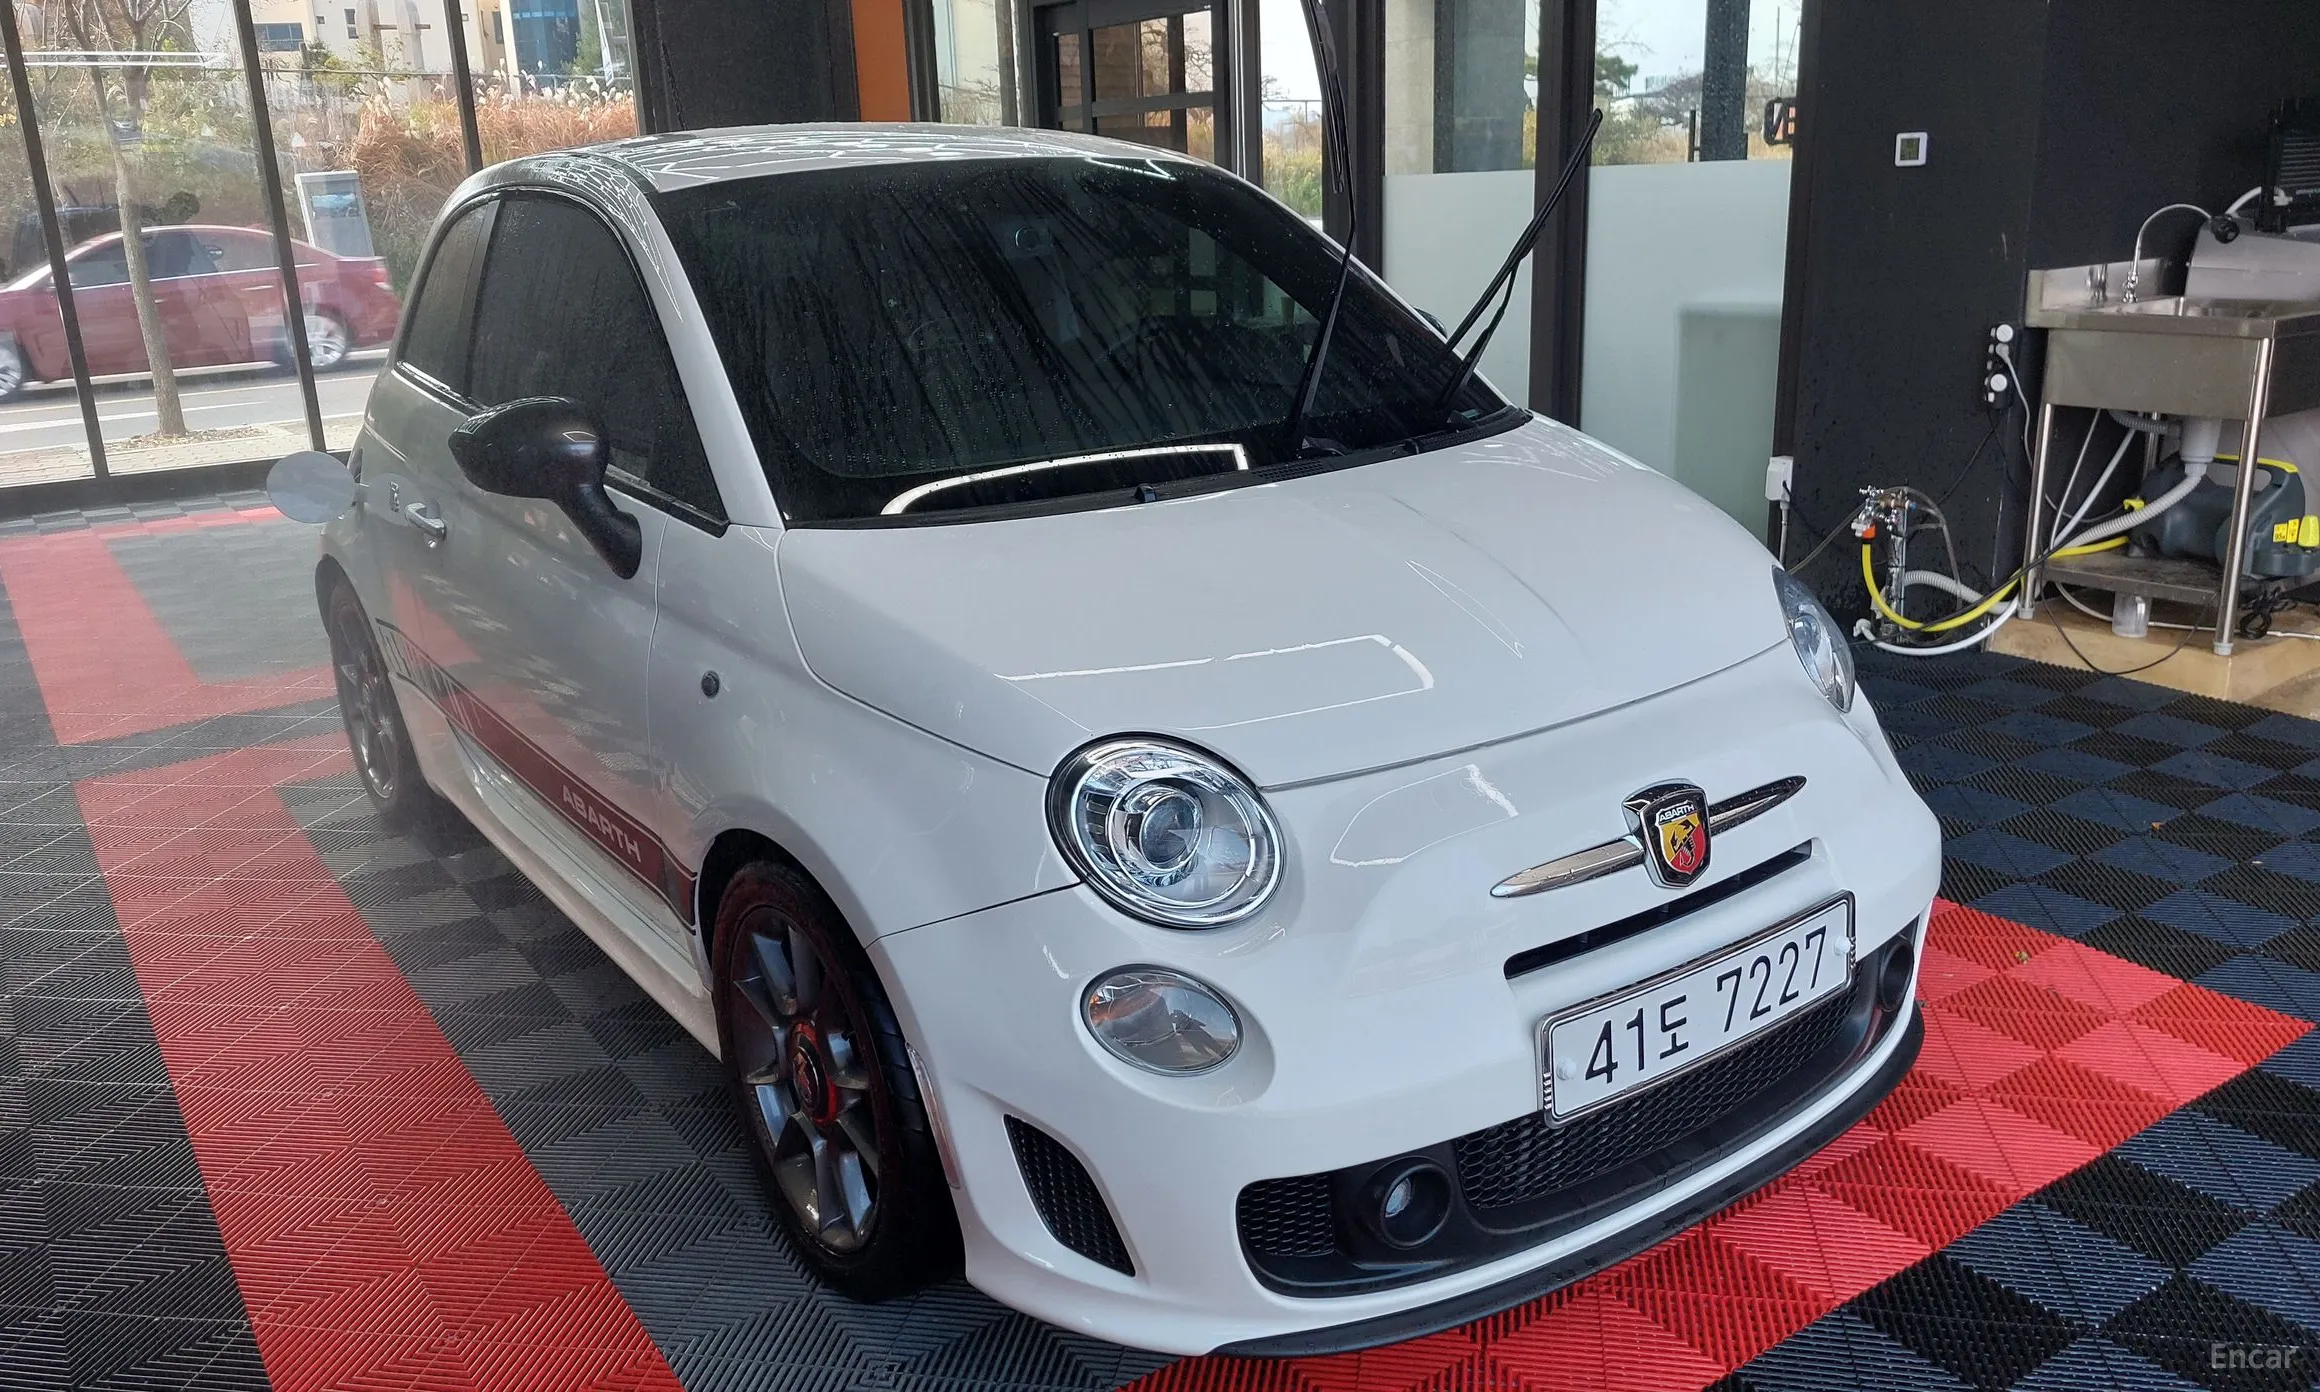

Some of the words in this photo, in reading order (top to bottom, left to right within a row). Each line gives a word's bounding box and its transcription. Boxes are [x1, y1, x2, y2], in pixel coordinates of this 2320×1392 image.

[563, 785, 641, 862] ABARTH
[1660, 804, 1694, 821] ABARTH
[1585, 995, 1689, 1084] 41도
[1716, 925, 1827, 1033] 7227
